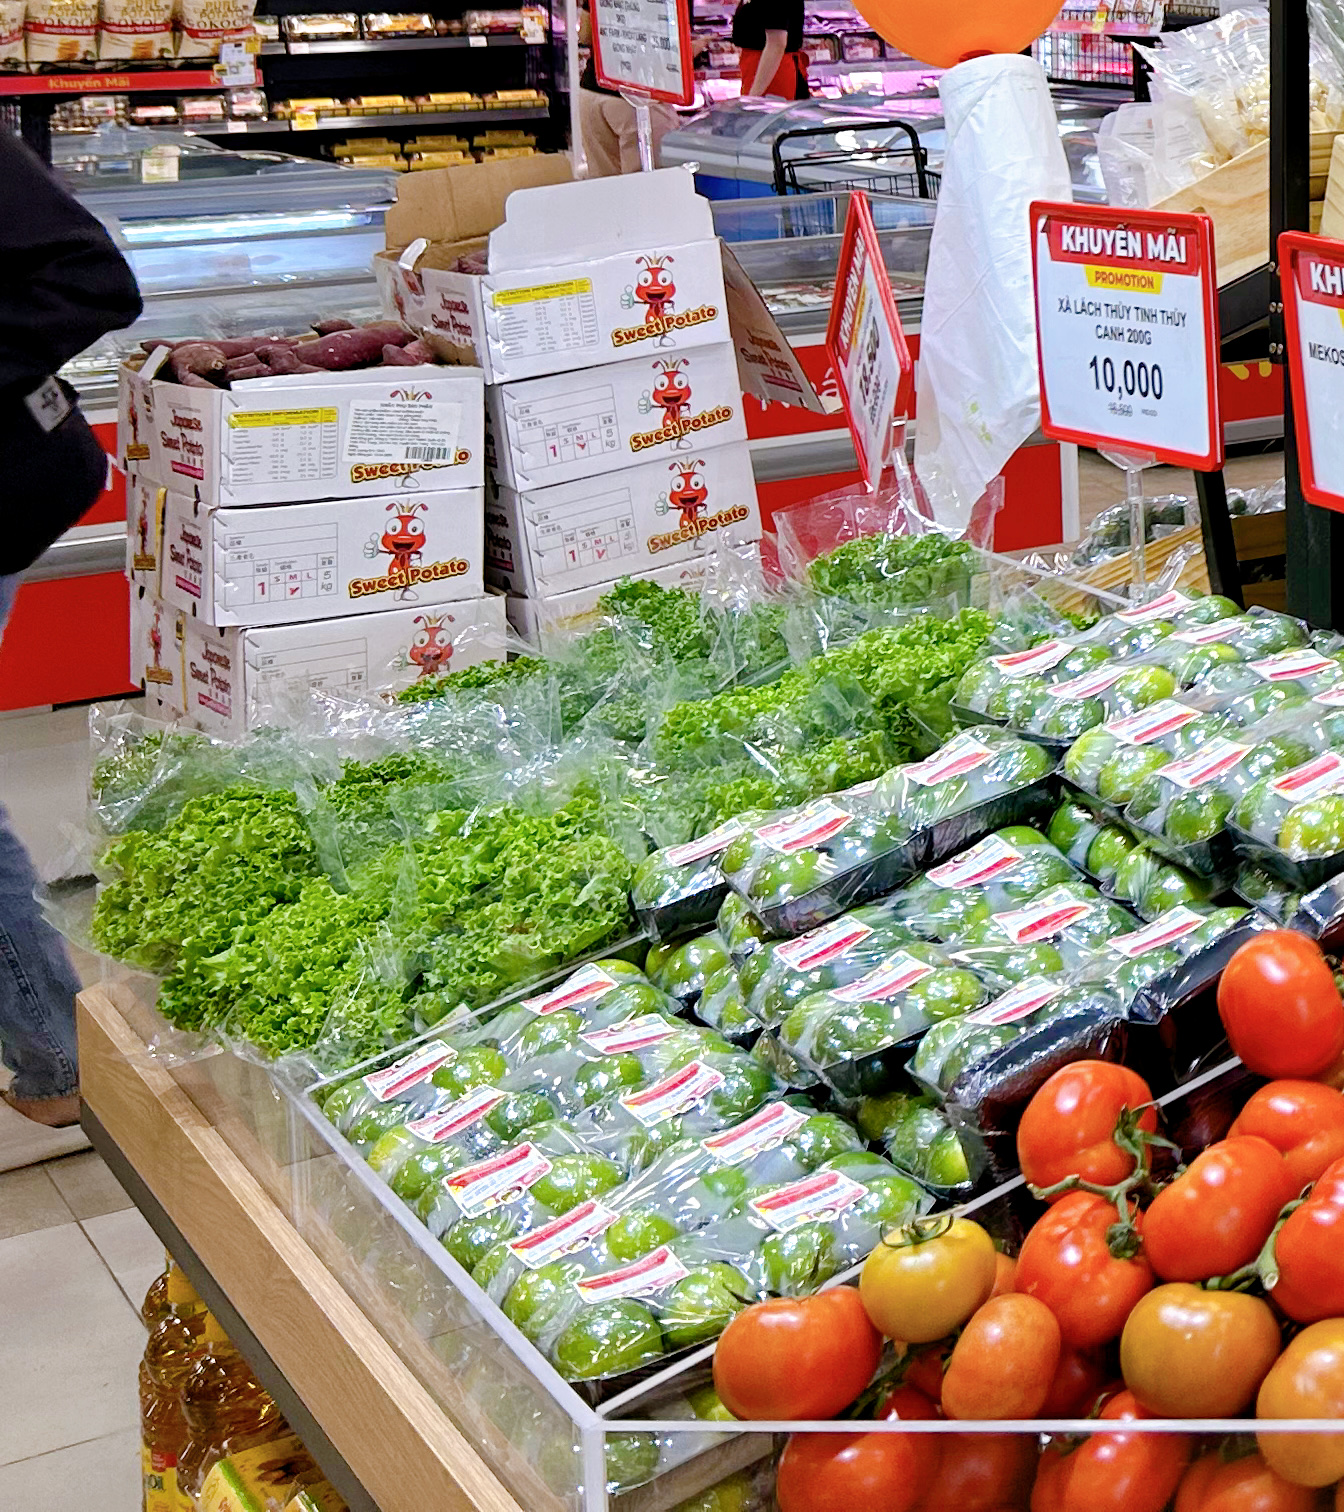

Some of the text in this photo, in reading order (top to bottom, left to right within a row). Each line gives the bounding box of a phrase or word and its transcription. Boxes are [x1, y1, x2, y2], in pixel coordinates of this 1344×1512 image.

[1061, 223, 1188, 263] KHUYẾN MÃI
[1094, 271, 1155, 289] PROMOTION
[612, 305, 718, 347] Sweet Potato
[1074, 297, 1101, 318] LÁCH
[1135, 306, 1158, 323] TINH
[1095, 325, 1153, 346] CANH 200G
[1090, 355, 1163, 401] 10,000
[630, 406, 734, 453] Sweet Potato
[648, 506, 750, 555] Sweet Potato
[350, 558, 471, 598] Sweet Potato
